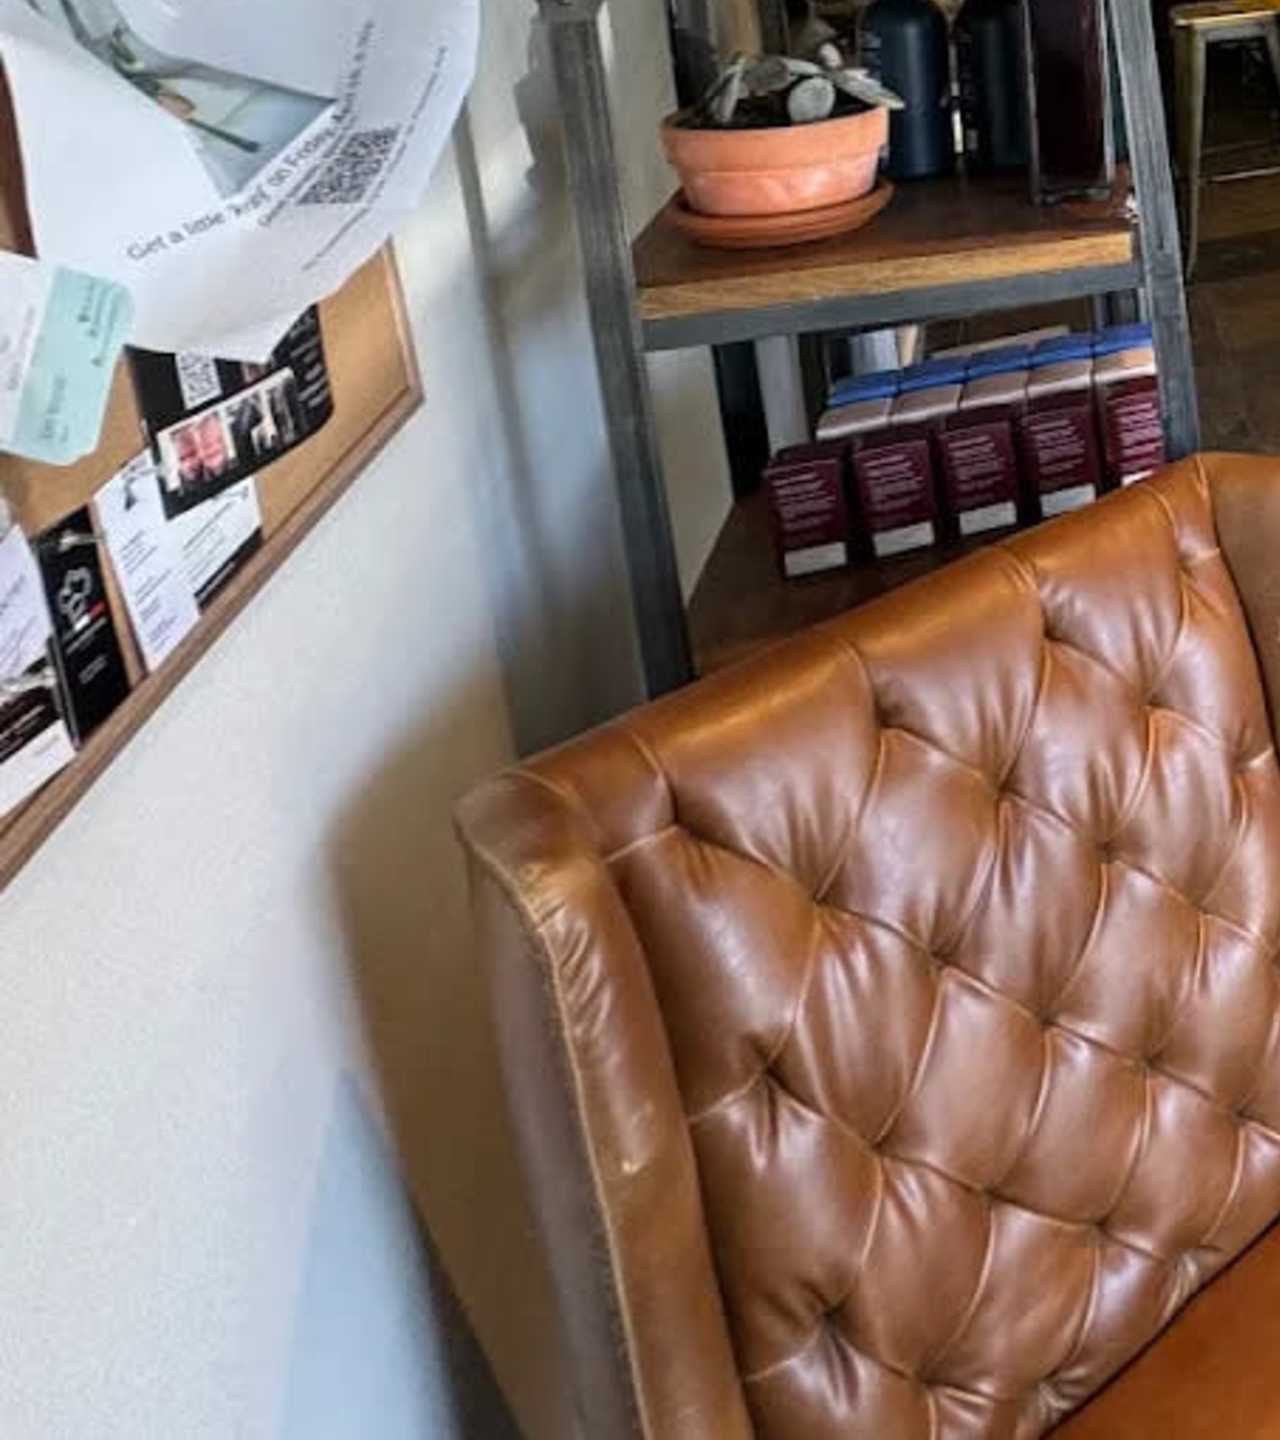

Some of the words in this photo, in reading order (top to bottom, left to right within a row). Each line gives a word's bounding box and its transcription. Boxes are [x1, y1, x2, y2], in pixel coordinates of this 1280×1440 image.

[126, 234, 169, 262] Get
[169, 229, 187, 245] a
[182, 211, 226, 237] little
[266, 166, 292, 187] on
